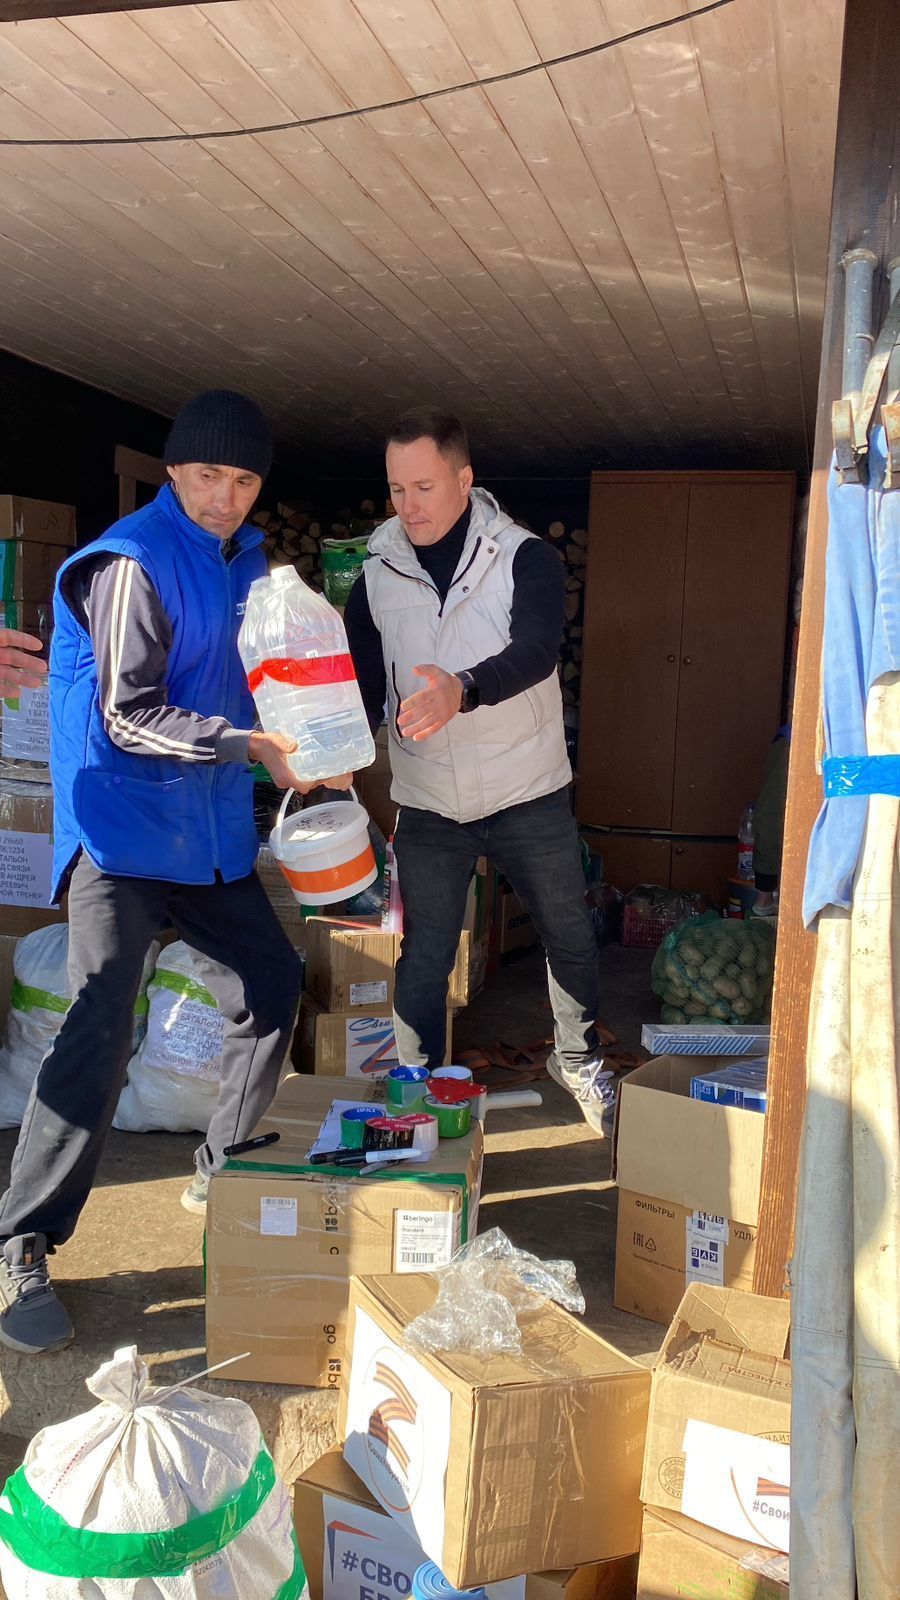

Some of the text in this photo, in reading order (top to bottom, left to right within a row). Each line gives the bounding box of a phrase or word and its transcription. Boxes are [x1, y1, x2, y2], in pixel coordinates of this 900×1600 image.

[7, 864, 31, 873] СВЯЗИ
[7, 873, 36, 881] АНДРЕЙ
[17, 890, 43, 899] ТРЕНЕР
[635, 1200, 675, 1219] ФИЛЬТРЫ
[341, 1550, 412, 1595] #СВО
